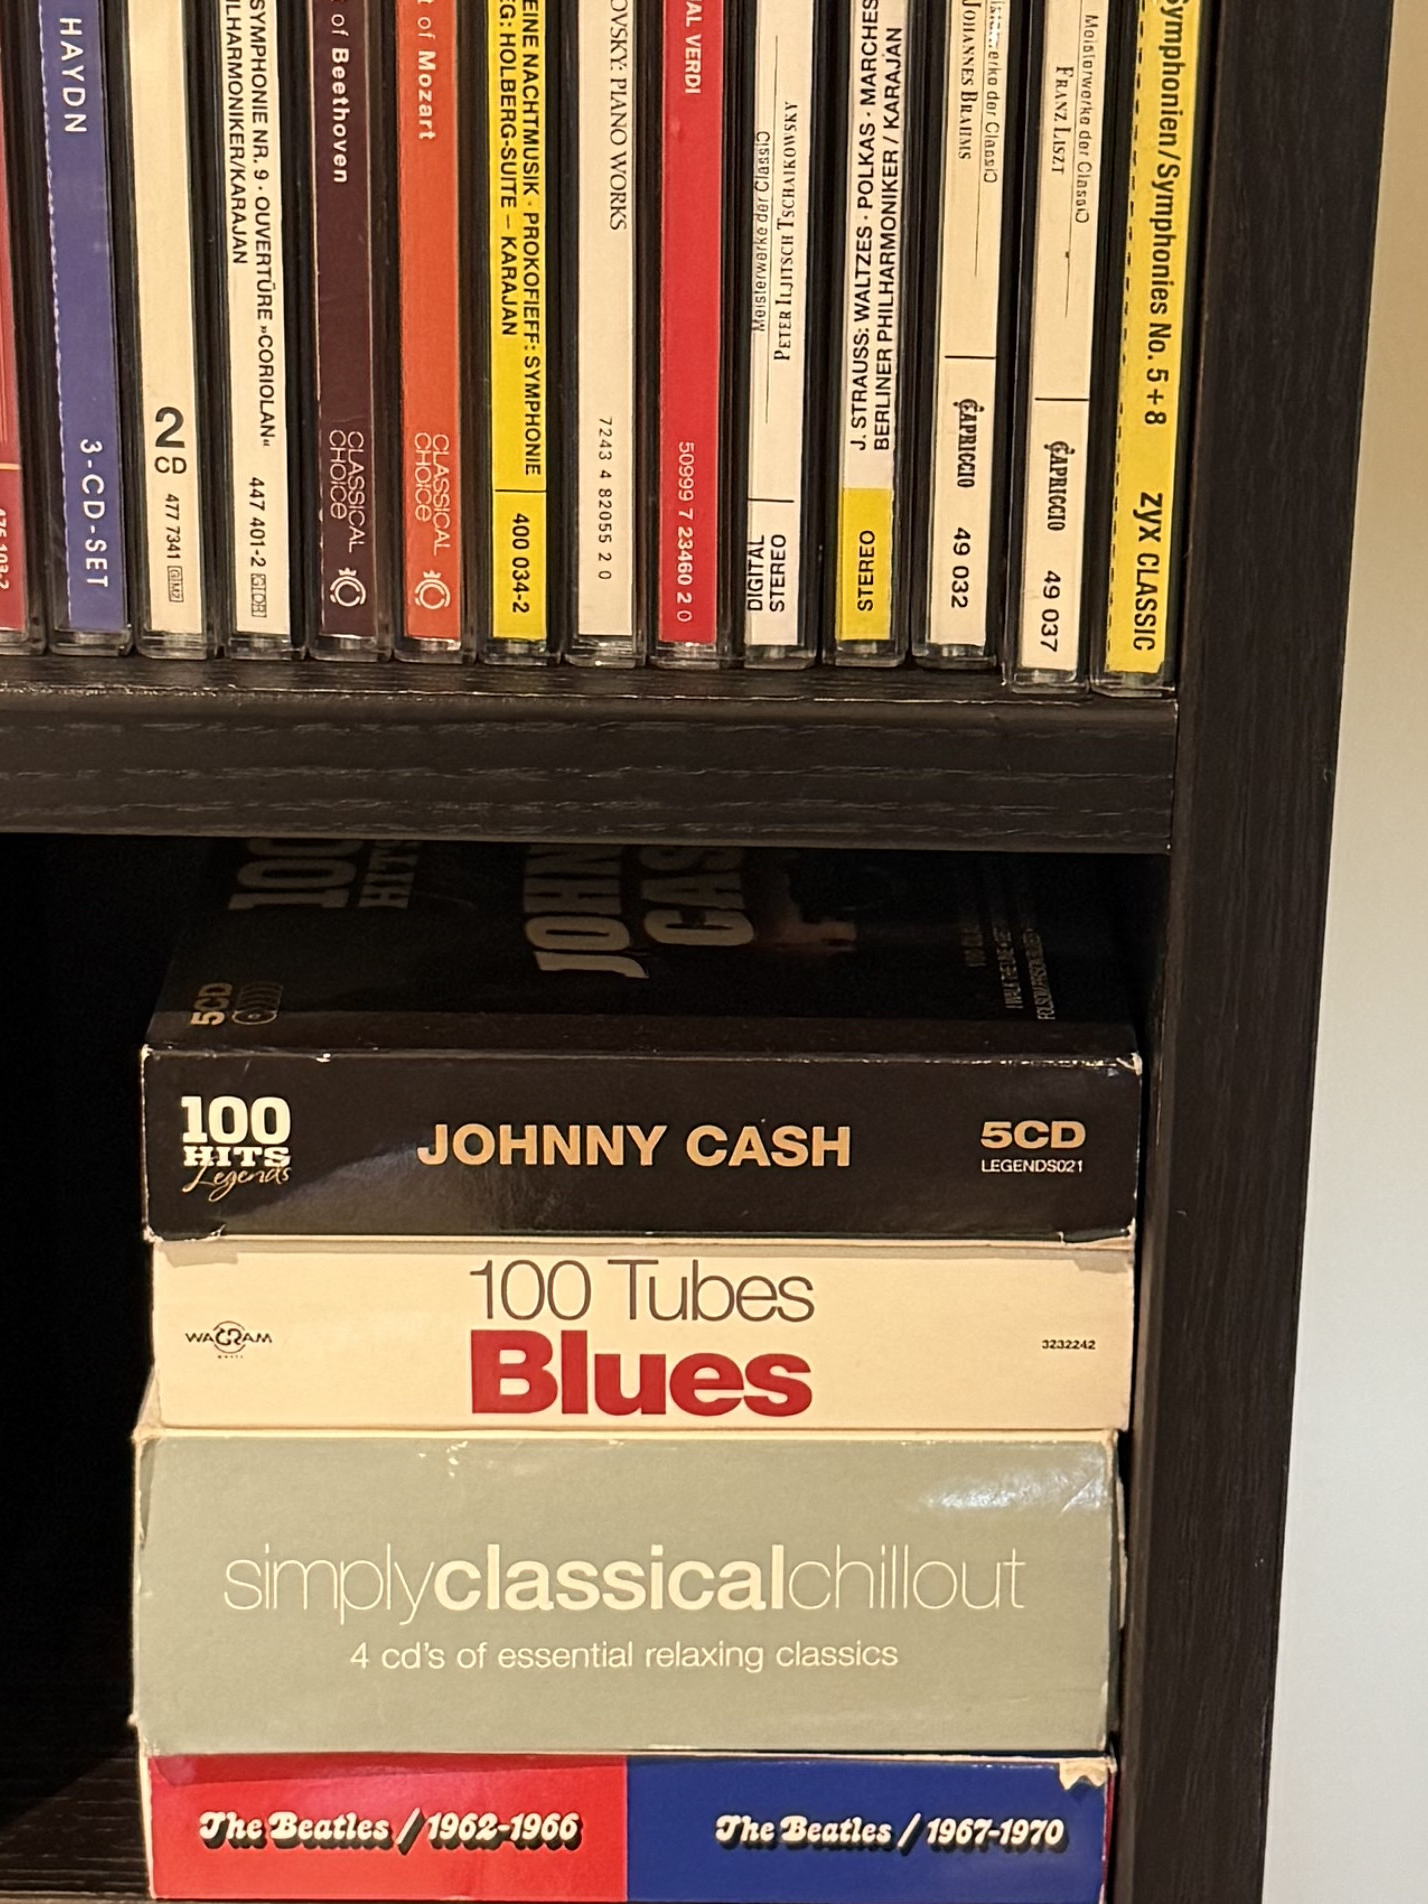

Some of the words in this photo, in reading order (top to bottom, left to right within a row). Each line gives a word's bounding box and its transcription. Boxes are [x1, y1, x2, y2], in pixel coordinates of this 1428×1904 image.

[60, 17, 87, 133] HAYDN
[685, 35, 701, 94] VERDI
[885, 27, 902, 129] KARAJAN
[961, 0, 981, 86] JOHANNES
[331, 48, 350, 182] Beethoven
[418, 51, 435, 140] Mozart
[499, 34, 517, 208] HOLBERG-SUITE
[522, 55, 540, 195] NACHTMUSIK
[610, 78, 627, 145] PIANO
[958, 91, 978, 160] BRAHMS
[1054, 66, 1074, 123] FRANZ
[778, 101, 799, 231] TSCHAIKOWSKY
[857, 124, 876, 210] POLKAS
[1052, 128, 1072, 175] LISZT
[610, 154, 627, 230] WORKS
[254, 197, 276, 321] OUVERTÜRE
[523, 213, 541, 350] PROKOFIEFF:
[775, 234, 793, 308] ILJITSCH
[855, 225, 872, 322] WALTZES
[879, 149, 900, 344] PHILHARMONIKER
[502, 237, 517, 336] KARAJAN
[774, 312, 791, 362] PETER
[852, 327, 870, 429] STRAUSS:
[875, 350, 893, 450] BERLINER
[154, 406, 185, 448] 2
[524, 355, 542, 476] SYMPHONIE
[599, 418, 613, 460] 7243
[154, 456, 187, 475] CD
[347, 432, 365, 553] CLASSICAL
[432, 434, 450, 556] CLASSICAL
[80, 438, 108, 588] 3-CD-SET
[511, 514, 530, 549] 400
[953, 527, 971, 556] 49
[511, 557, 530, 613] 034-2
[677, 527, 694, 585] 23460
[747, 534, 764, 612] DIGITAL
[770, 534, 786, 612] STEREO
[858, 530, 875, 612] STEREO
[952, 566, 969, 608] 032
[1042, 570, 1061, 600] 49
[1040, 610, 1058, 652] 037
[1133, 553, 1159, 651] CLASSIC
[181, 1096, 290, 1142] 100
[417, 1125, 667, 1166] JOHNNY
[686, 1125, 850, 1166] CASH
[980, 1121, 1085, 1149] 5CD
[182, 1160, 292, 1202] Legends
[184, 1146, 290, 1166] HITS
[980, 1158, 1082, 1173] LEGENDS021
[470, 1259, 592, 1320] 100
[608, 1259, 815, 1322] Tubes
[471, 1330, 813, 1416] Blues
[1042, 1340, 1095, 1349] 3232242
[350, 1642, 369, 1669] 4
[381, 1641, 444, 1669] cd's
[457, 1641, 488, 1668] of
[498, 1641, 633, 1669] essential
[645, 1641, 763, 1673] relaxing
[776, 1641, 898, 1667] classics
[199, 1811, 263, 1843] The
[269, 1811, 389, 1843] Beatles
[428, 1813, 580, 1843] 1962-1966
[715, 1815, 775, 1844] The
[781, 1816, 891, 1844] Beatles
[926, 1818, 1066, 1847] 1967-1970
